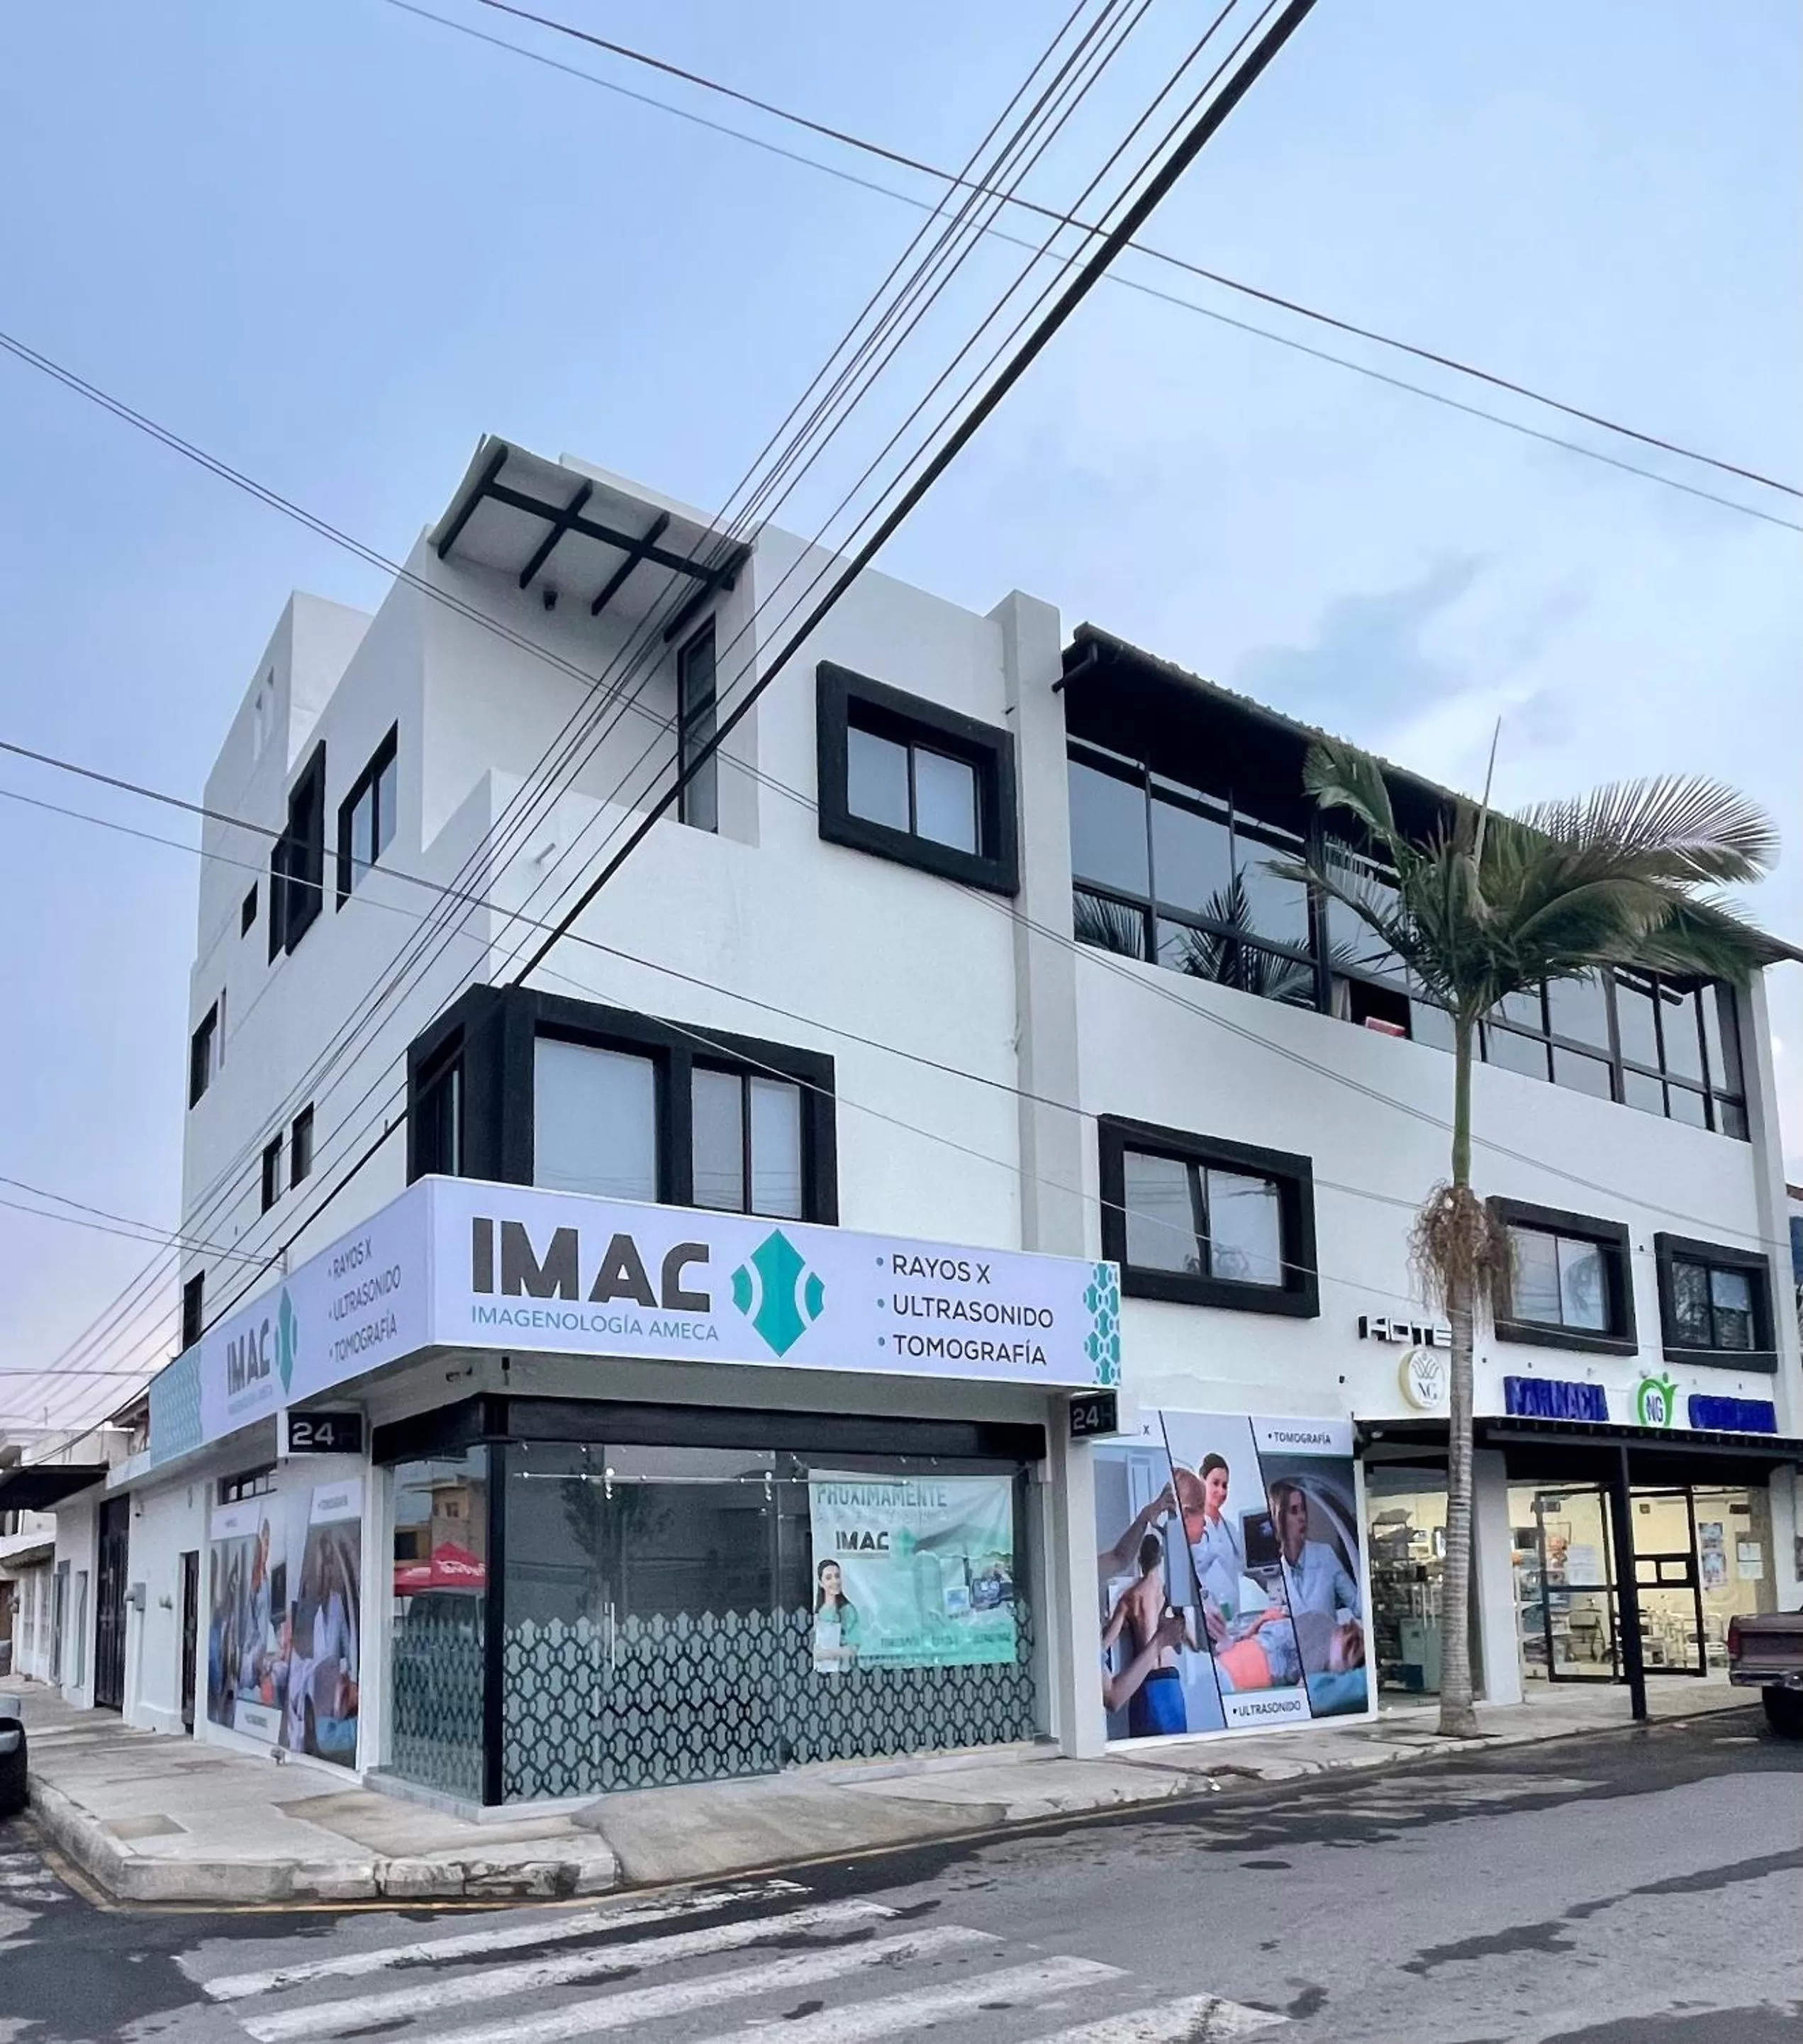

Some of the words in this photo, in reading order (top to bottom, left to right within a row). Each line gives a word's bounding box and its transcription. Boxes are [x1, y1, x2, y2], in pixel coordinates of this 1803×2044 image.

[333, 1241, 364, 1280] RAYOS
[364, 1236, 373, 1261] X
[472, 1217, 710, 1313] IMAC
[892, 1253, 971, 1283] RAYOS
[976, 1263, 990, 1284] X
[333, 1264, 401, 1322] ULTRASONIDO
[471, 1306, 642, 1336] IMAGENOLOGÍA
[649, 1321, 719, 1341] AMECA
[893, 1294, 1054, 1328] ULTRASONIDO
[335, 1308, 397, 1362] TOMOGRAFÍA
[1358, 1316, 1452, 1347] HOTE
[227, 1318, 270, 1397] IMAC
[893, 1334, 1047, 1366] TOMOGRAFÍA
[1646, 1395, 1663, 1423] NG
[1142, 1424, 1151, 1436] X
[835, 1530, 889, 1551] IMAC
[1239, 1700, 1300, 1716] ULTRASONIDO
